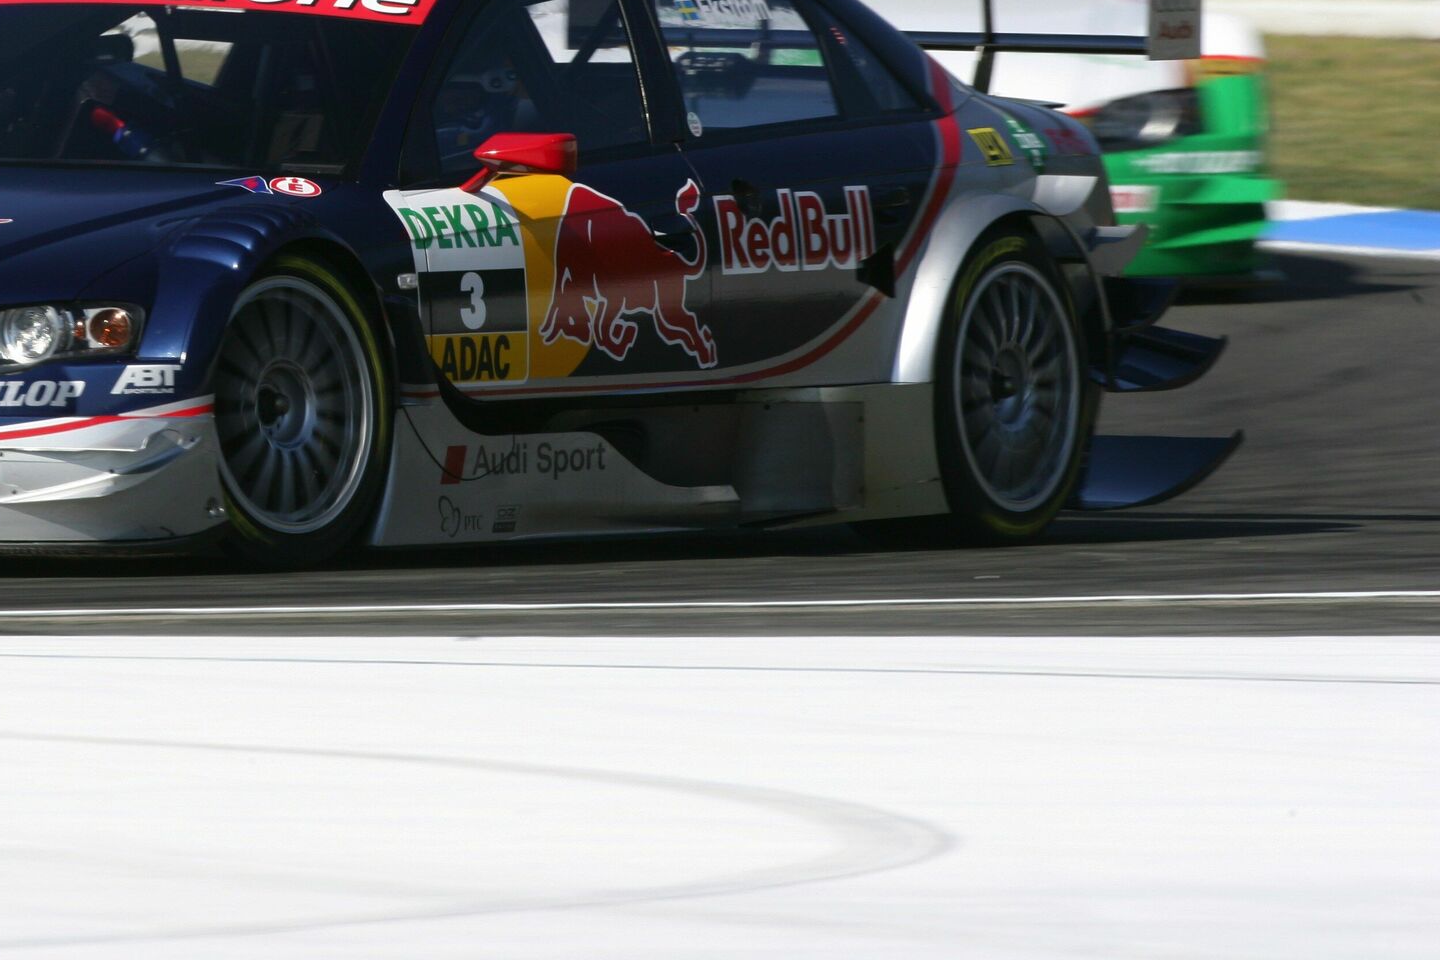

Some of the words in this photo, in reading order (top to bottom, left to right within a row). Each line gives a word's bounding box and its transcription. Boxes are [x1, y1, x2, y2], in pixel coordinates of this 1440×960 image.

[398, 202, 519, 250] DEKRA
[460, 272, 487, 330] 3
[111, 365, 182, 394] ABT
[441, 335, 510, 381] ADAC
[473, 443, 528, 475] Audi
[536, 442, 606, 480] Sport
